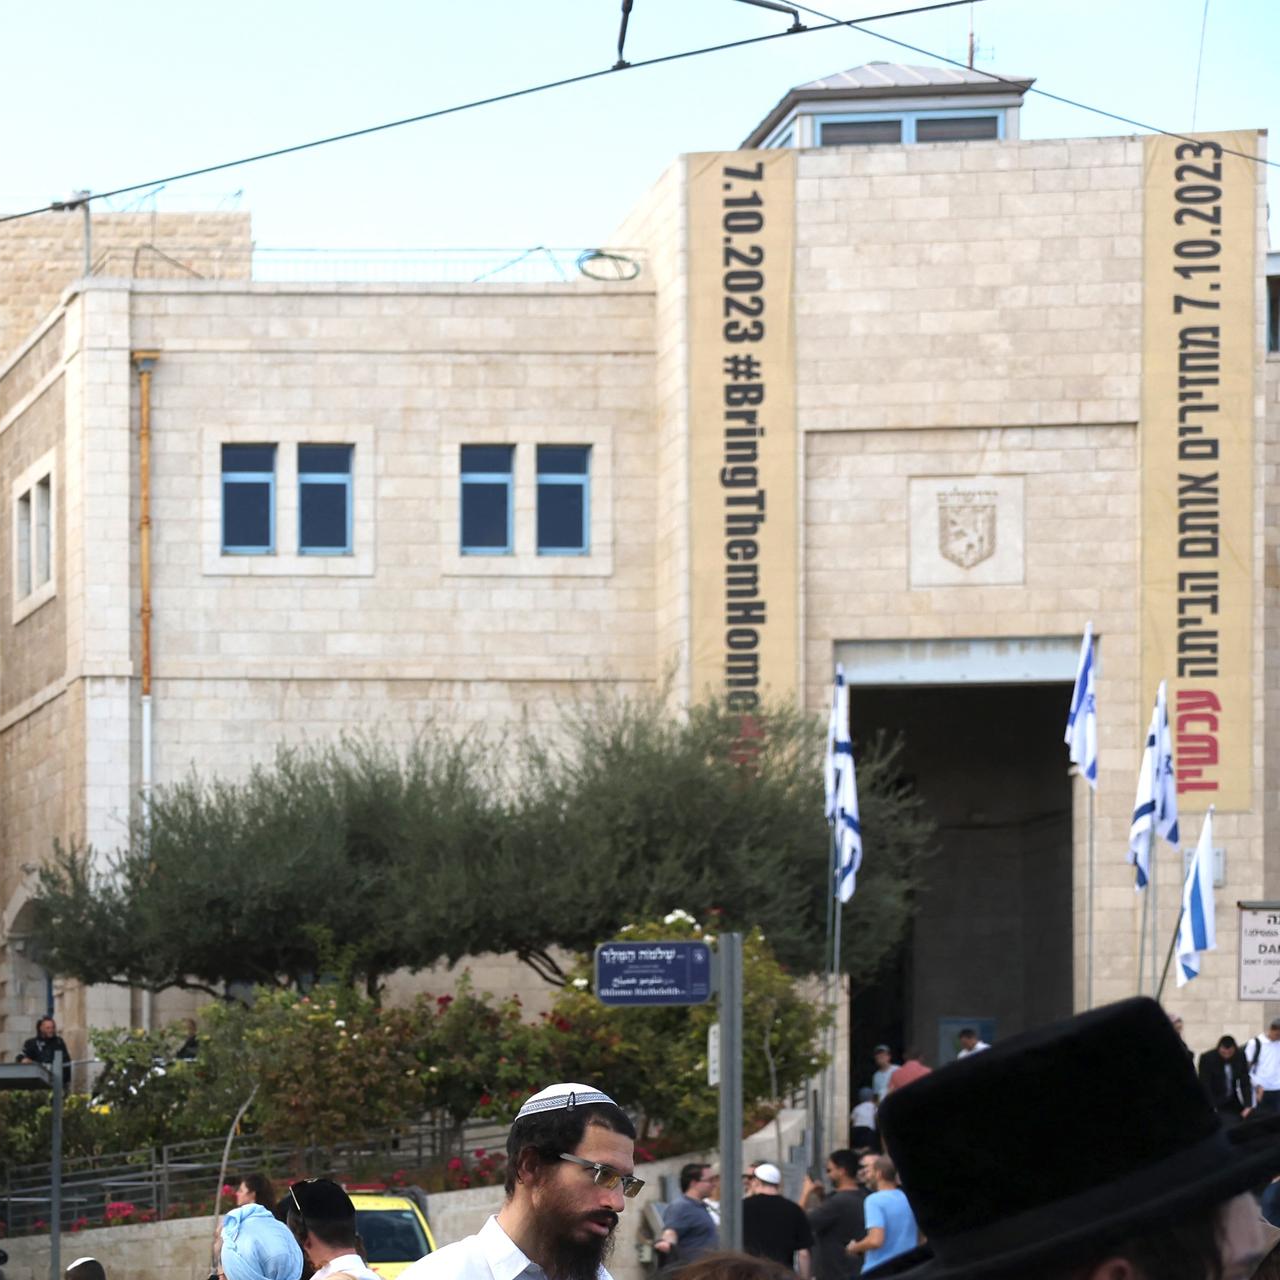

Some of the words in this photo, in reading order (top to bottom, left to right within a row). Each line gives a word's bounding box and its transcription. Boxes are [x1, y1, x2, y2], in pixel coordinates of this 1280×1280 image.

[723, 162, 764, 343] 7.10.2023
[1173, 141, 1223, 314] 7.10.2023
[1177, 326, 1220, 460] מחזירים
[720, 354, 766, 712] #BringThemHome
[1177, 472, 1219, 559] אותם
[1177, 572, 1219, 678] הביתה
[1176, 690, 1222, 794] עכשיו
